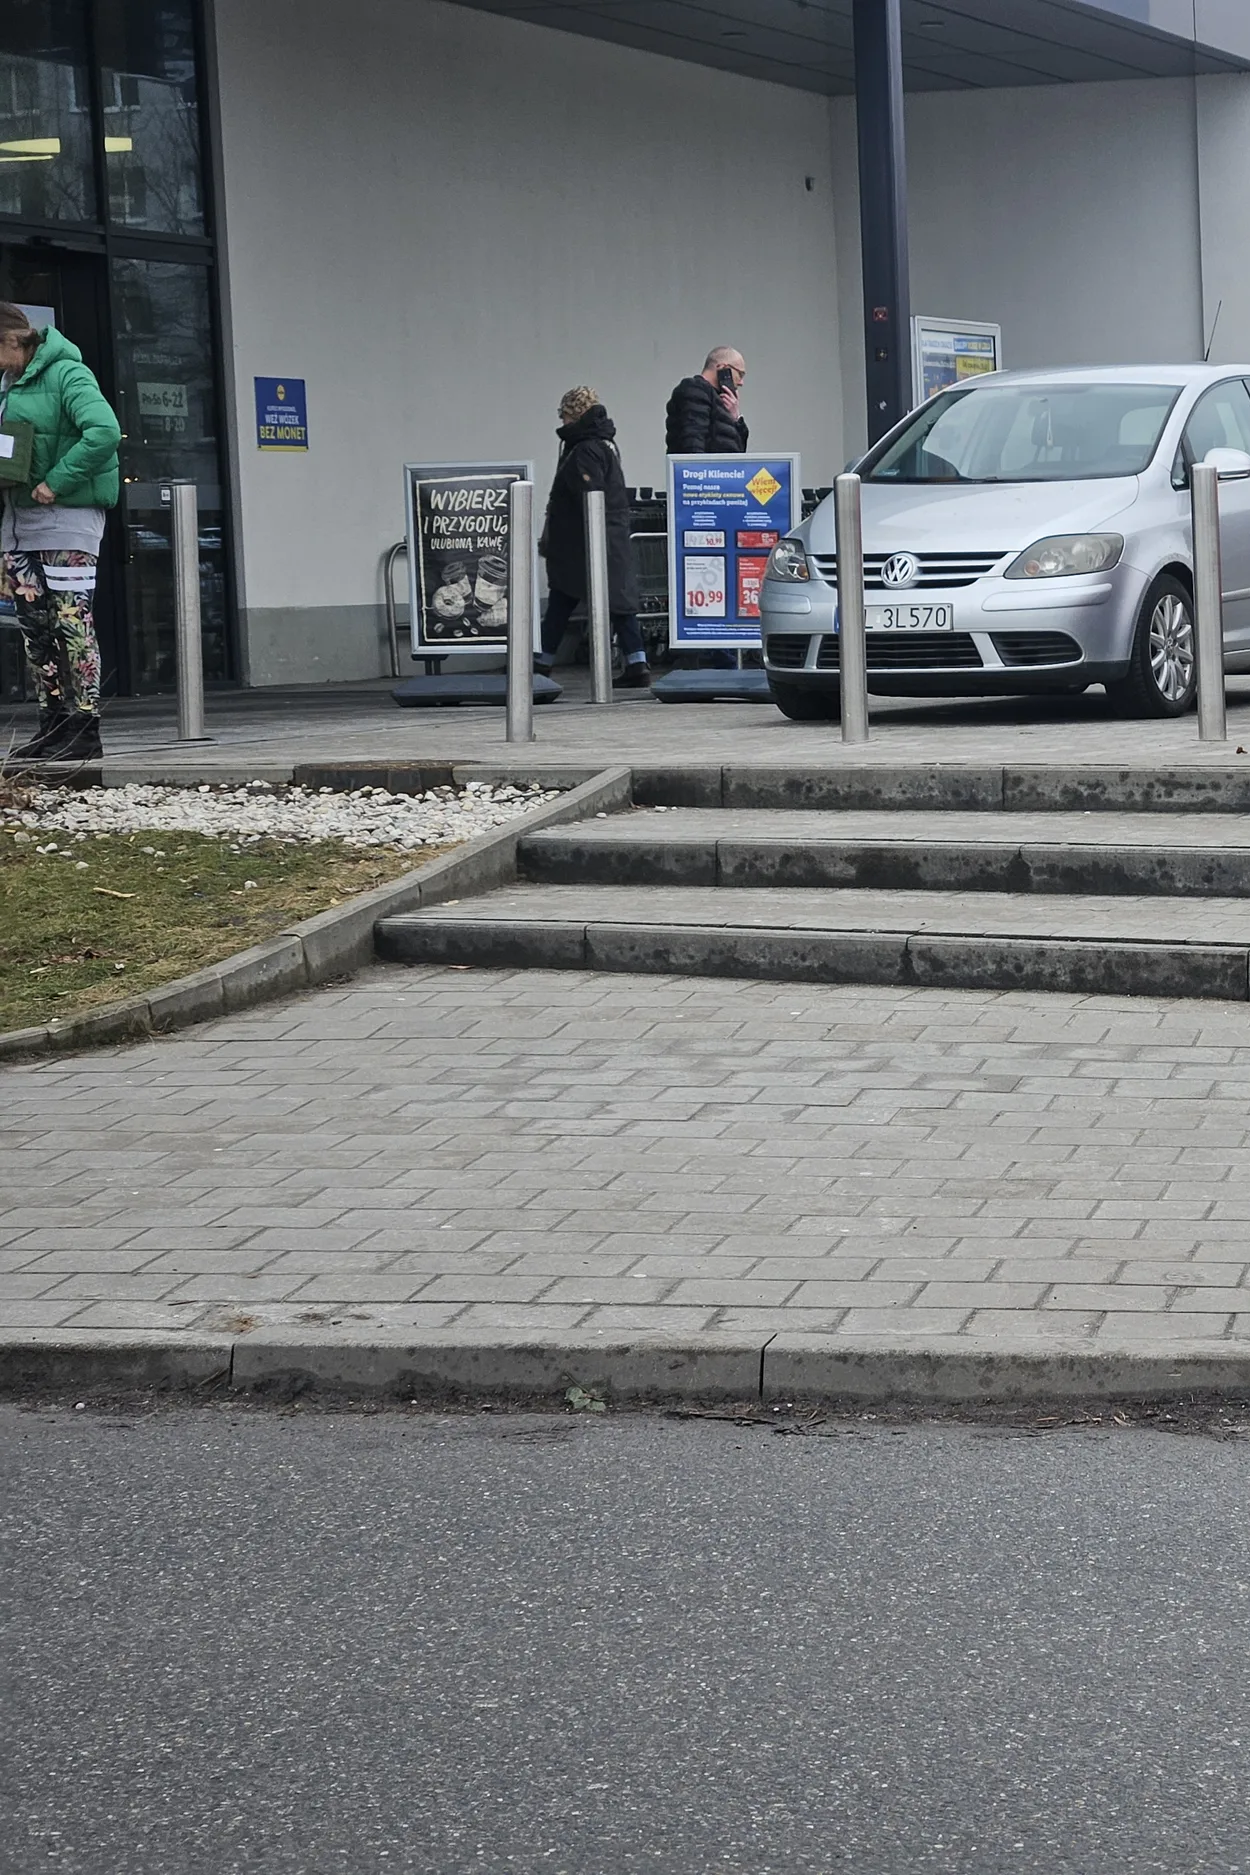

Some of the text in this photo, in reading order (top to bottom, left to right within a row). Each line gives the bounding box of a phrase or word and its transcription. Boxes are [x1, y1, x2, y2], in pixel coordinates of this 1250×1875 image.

[279, 413, 300, 425] WÓZEK
[260, 425, 306, 440] BEZ MONET
[682, 469, 745, 480] Drogi Kliencie!
[430, 488, 508, 511] WYBIERZ
[424, 516, 429, 534] I
[430, 536, 504, 552] ULUBIONĄ KAWĘ
[687, 590, 723, 607] 10.99
[883, 607, 946, 629] 3L570
